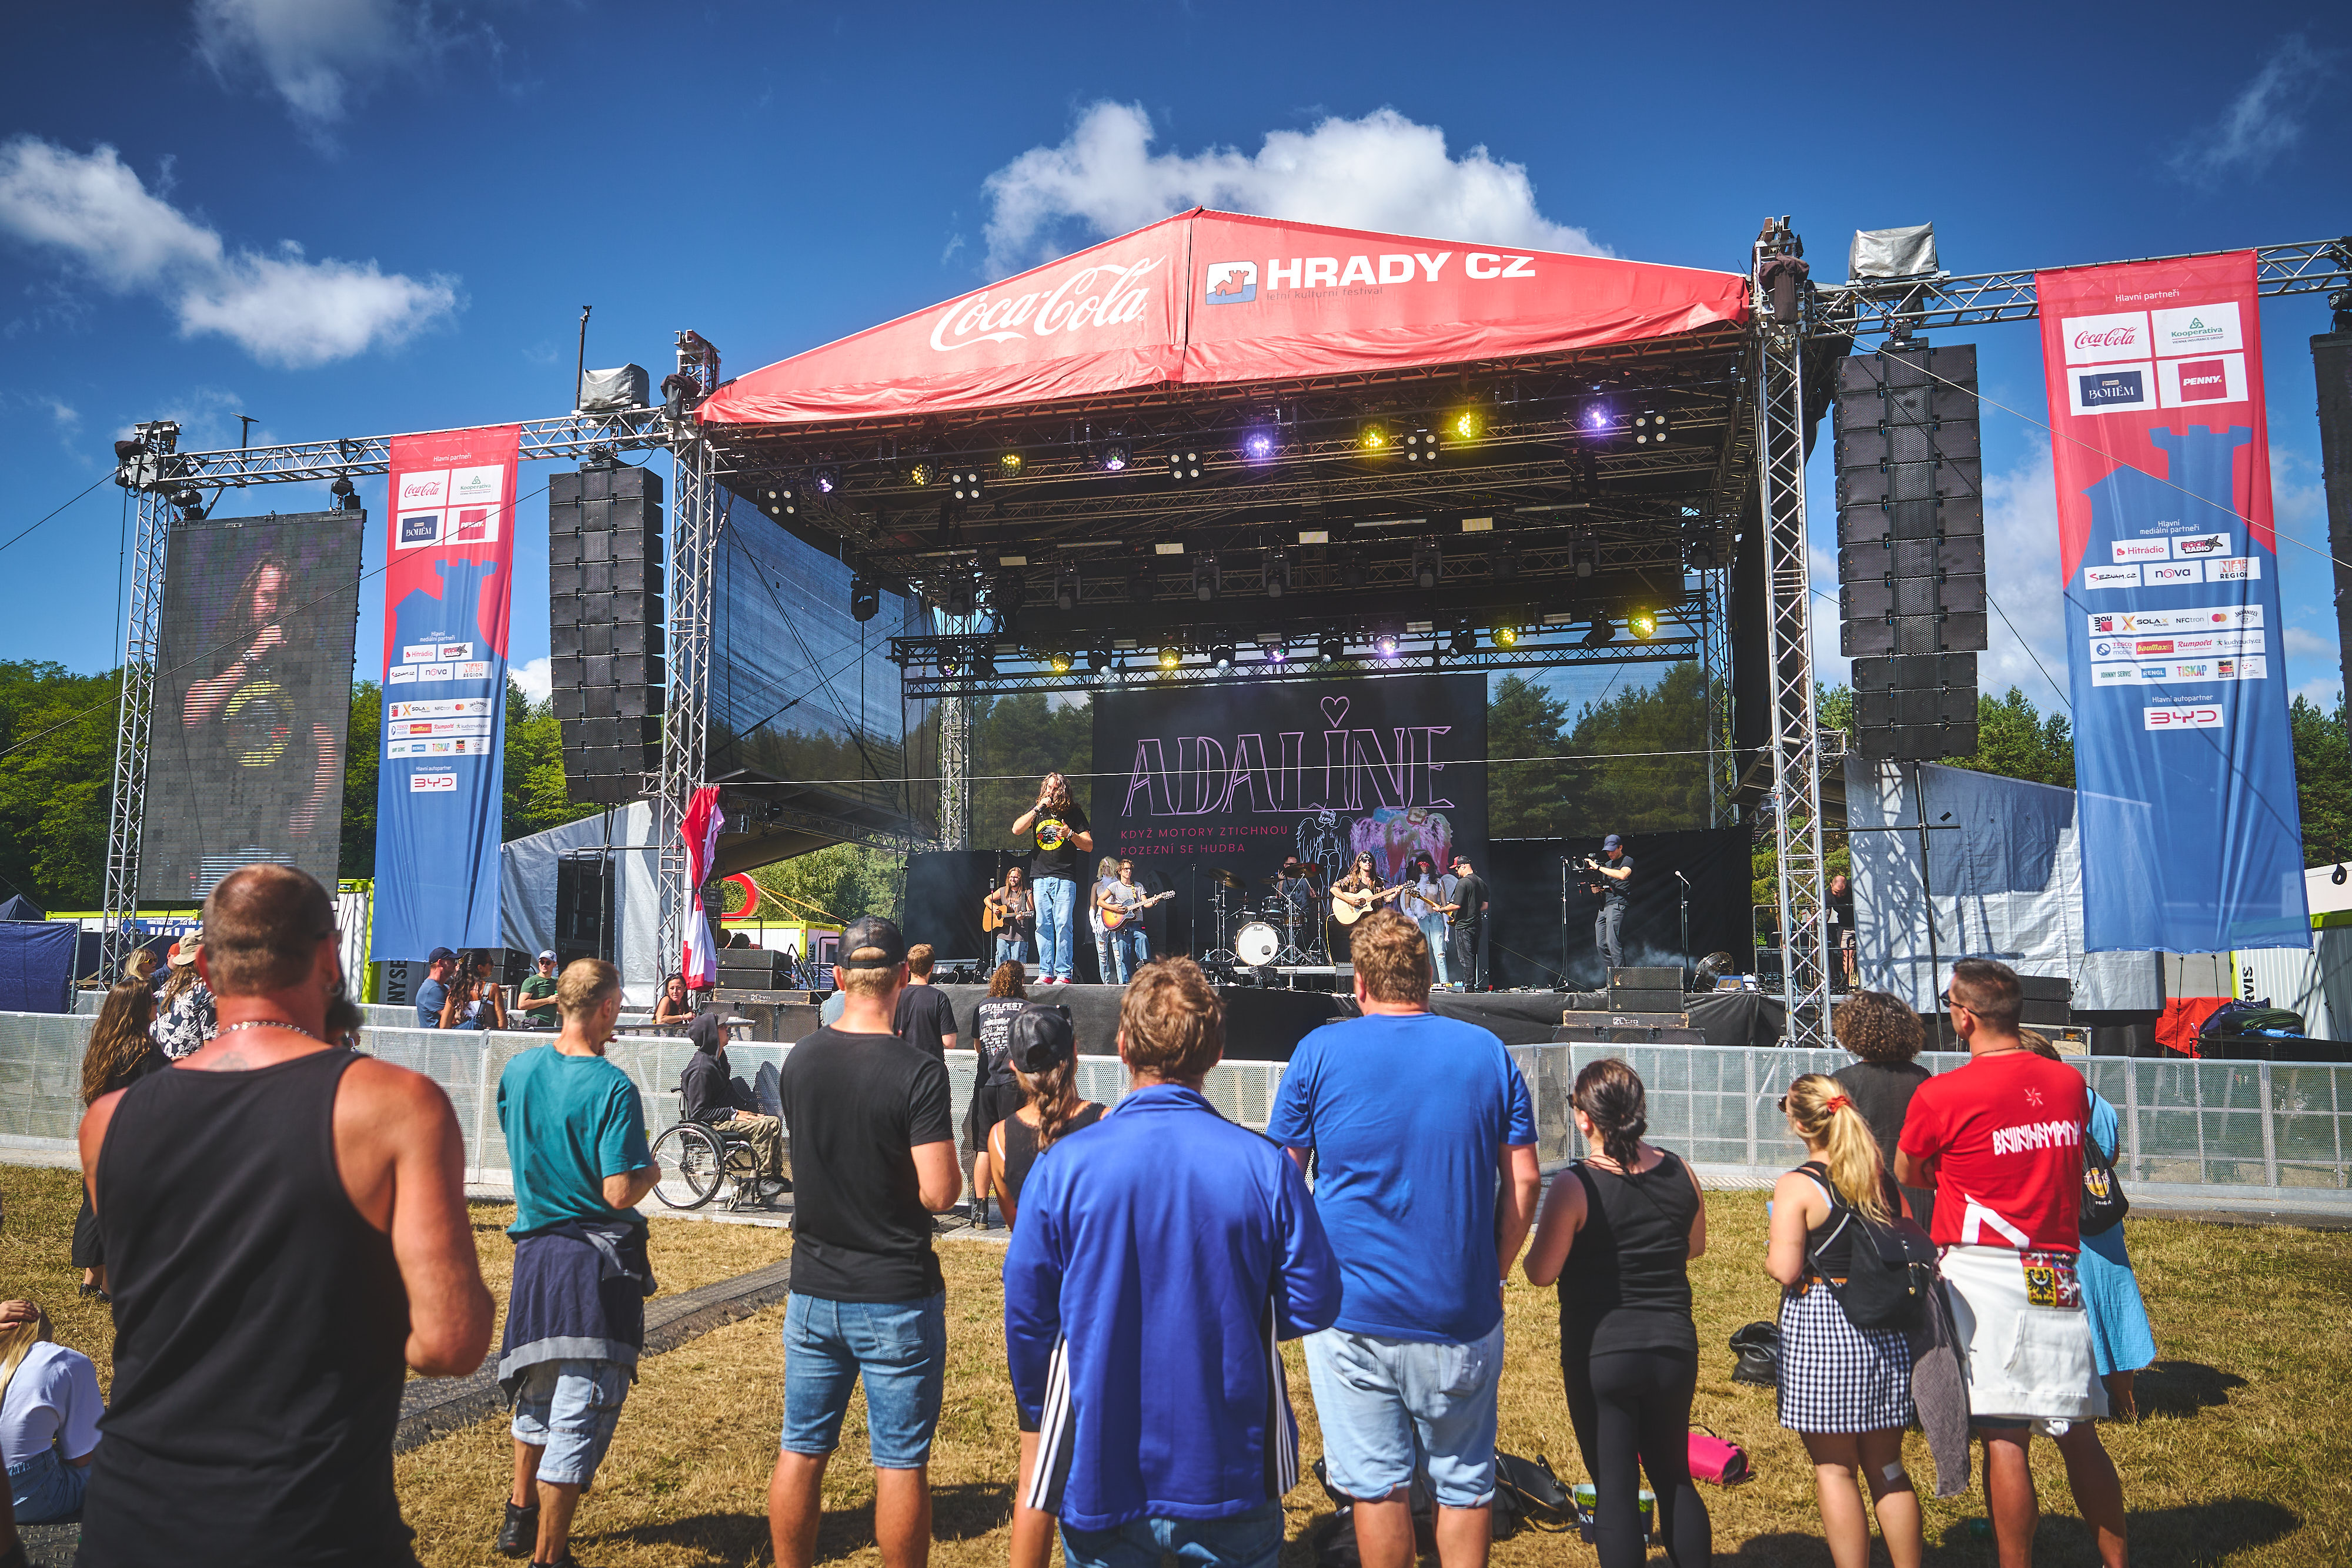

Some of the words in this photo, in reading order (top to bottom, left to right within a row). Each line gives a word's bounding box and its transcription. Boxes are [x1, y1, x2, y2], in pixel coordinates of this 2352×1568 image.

[1266, 252, 1452, 290] HRADY
[1464, 253, 1536, 280] CZ
[1267, 290, 1290, 300] letní
[1295, 288, 1338, 299] kulturní
[1343, 287, 1383, 296] festival
[2115, 292, 2141, 302] Hlavní
[2144, 289, 2179, 301] partneři
[2171, 327, 2223, 337] Kooperativa
[2089, 385, 2134, 399] BOHÉM
[450, 453, 472, 462] partneři
[406, 527, 432, 537] BOHÉM
[2140, 526, 2168, 534] mediální
[2170, 524, 2200, 534] partneři
[2127, 546, 2164, 554] Hitrádio
[2155, 569, 2191, 578] nova
[2177, 639, 2212, 647] Rumpold
[2177, 665, 2207, 677] TISKAP
[2174, 694, 2213, 703] autopartner
[2150, 710, 2217, 724] BYD
[432, 743, 450, 752] TISKAP
[1121, 725, 1455, 817] ADALINE
[415, 778, 453, 787] BYD
[1121, 828, 1152, 839] KDYŽ
[1159, 828, 1214, 838] MOTORY
[1220, 825, 1288, 836] ZTICHNOU
[1121, 843, 1174, 855] ROZEZNÍ
[1180, 845, 1194, 854] SE
[1201, 844, 1245, 853] HUDBA
